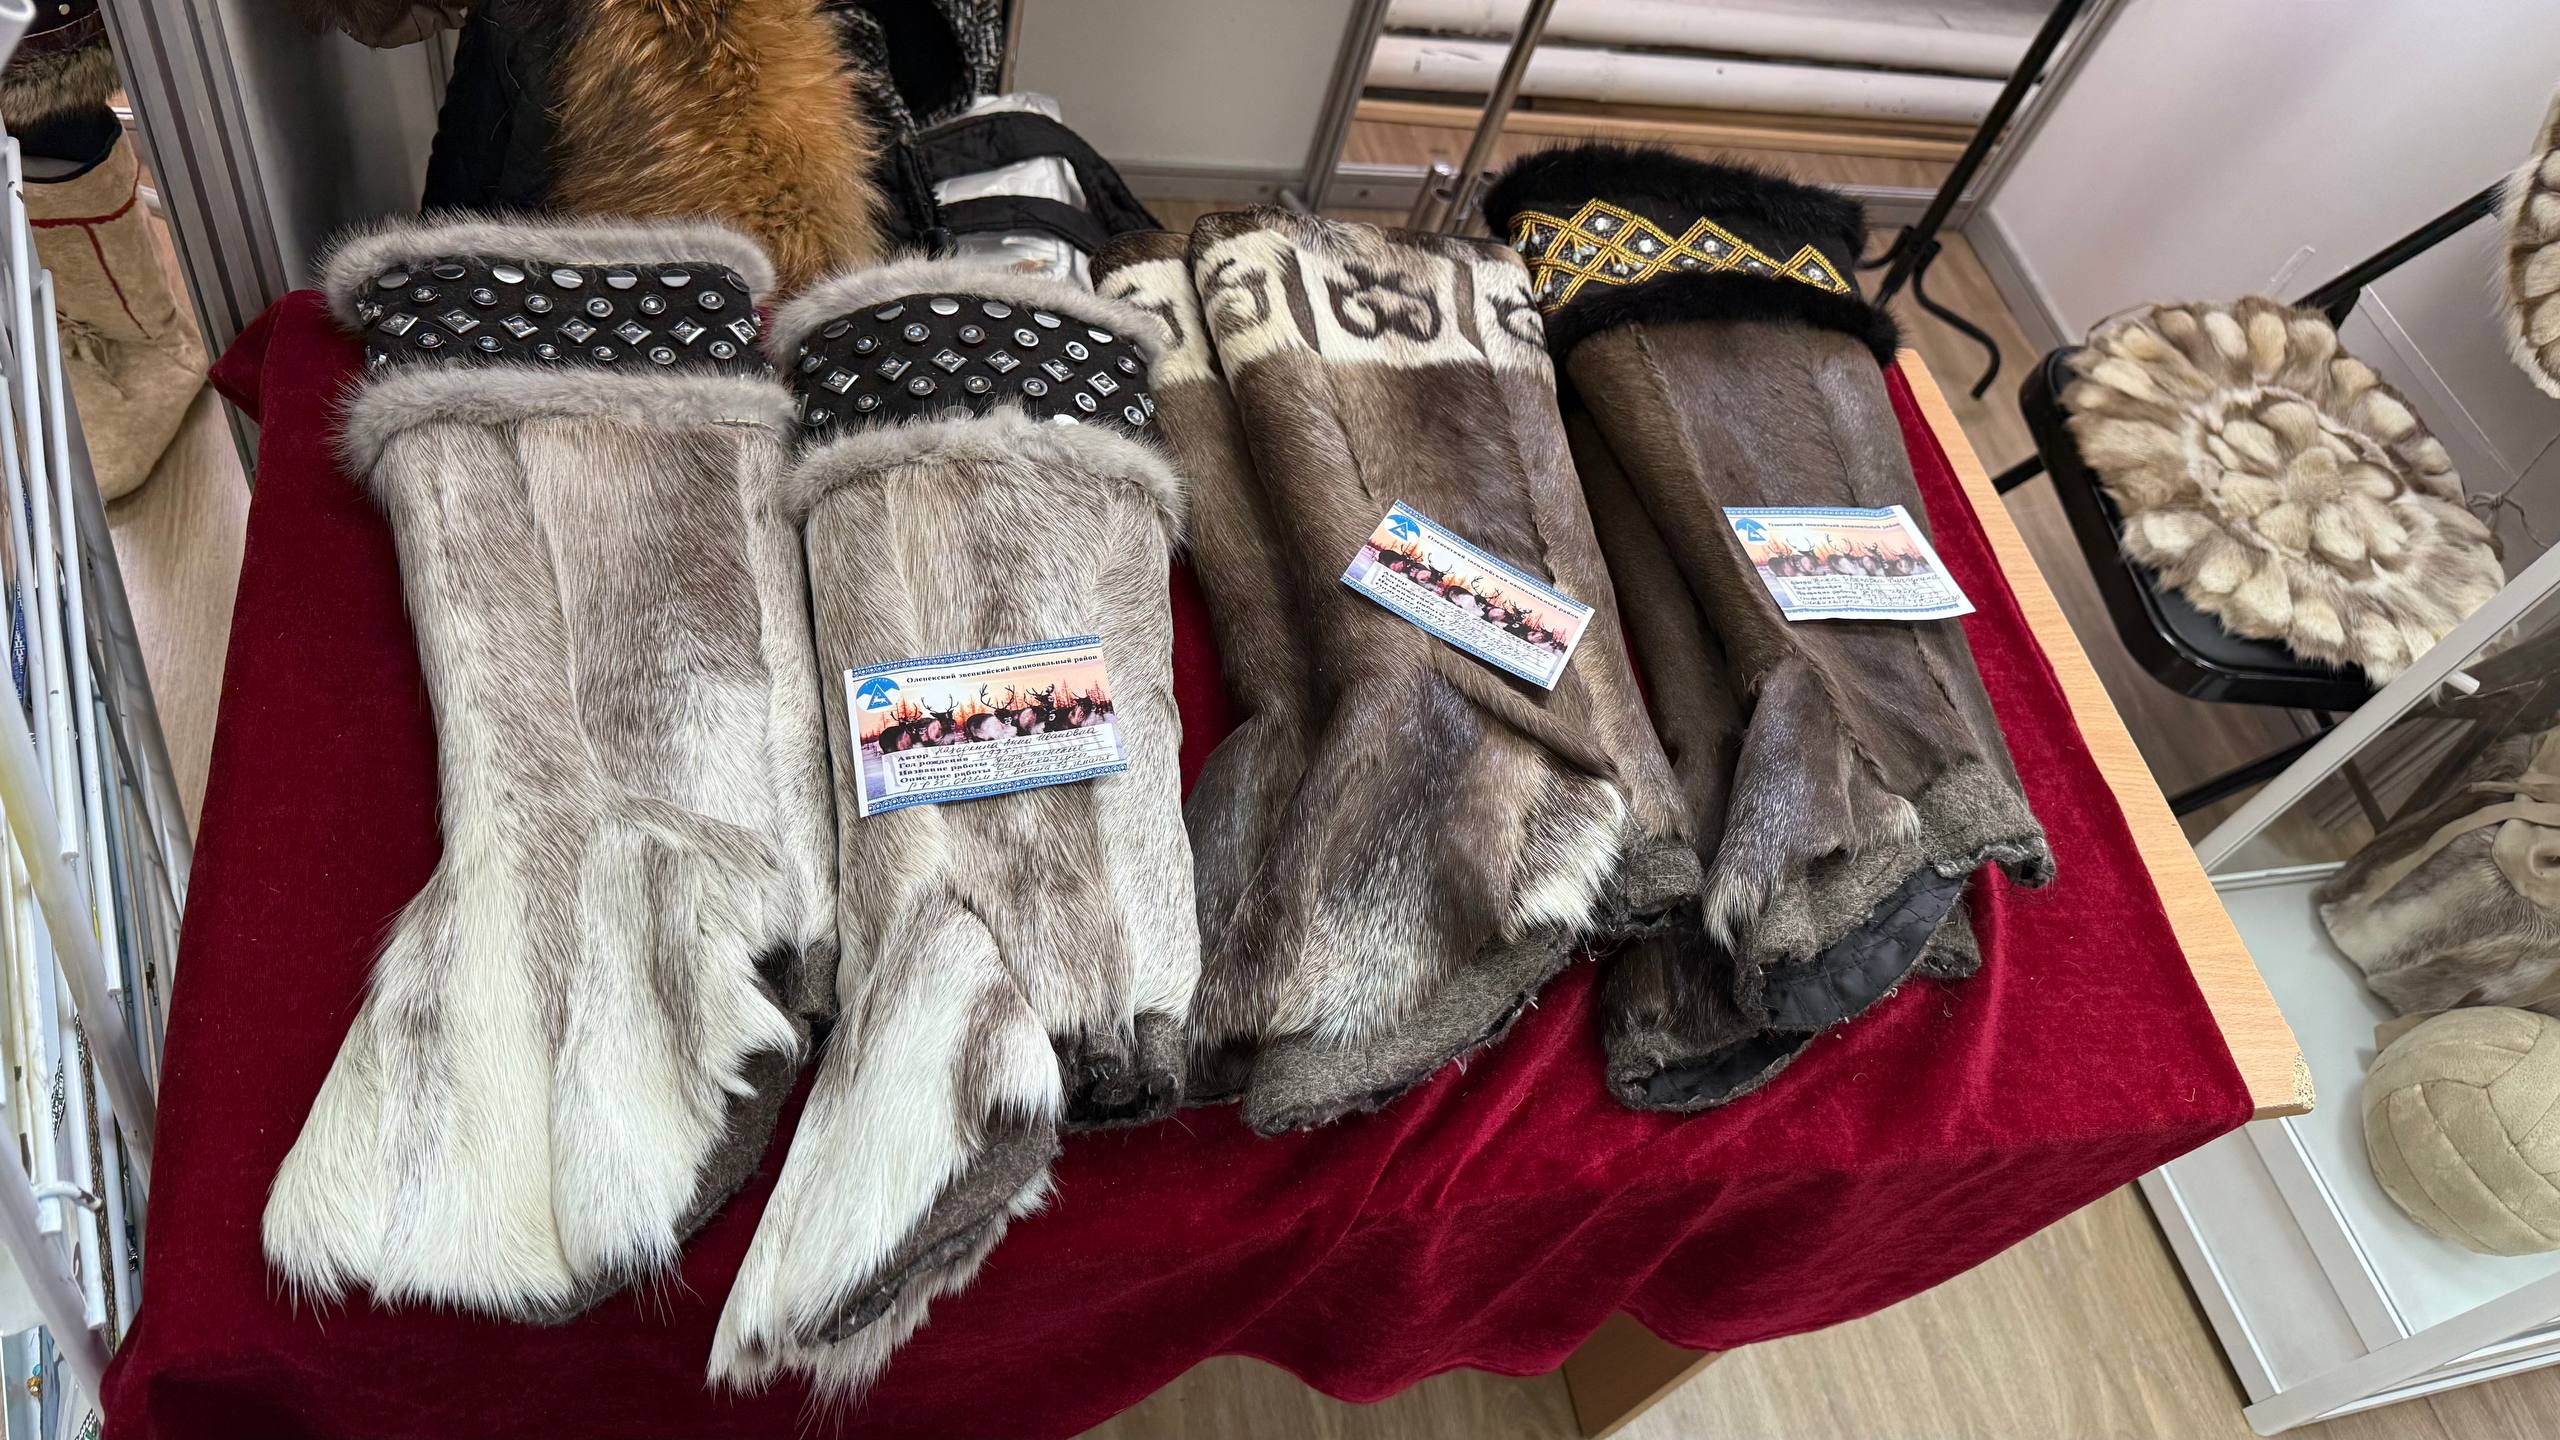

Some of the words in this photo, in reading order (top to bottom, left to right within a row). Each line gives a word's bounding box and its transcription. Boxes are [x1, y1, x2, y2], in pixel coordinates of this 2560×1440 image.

[906, 673, 956, 684] Оленекский
[958, 666, 1010, 679] эвенкийский
[1012, 657, 1072, 671] национальный
[1074, 654, 1098, 664] район
[898, 752, 929, 762] Автор
[919, 757, 969, 768] рождения
[899, 766, 948, 776] Название
[951, 761, 988, 771] работы
[900, 773, 951, 783] Описание
[954, 768, 991, 778] работы
